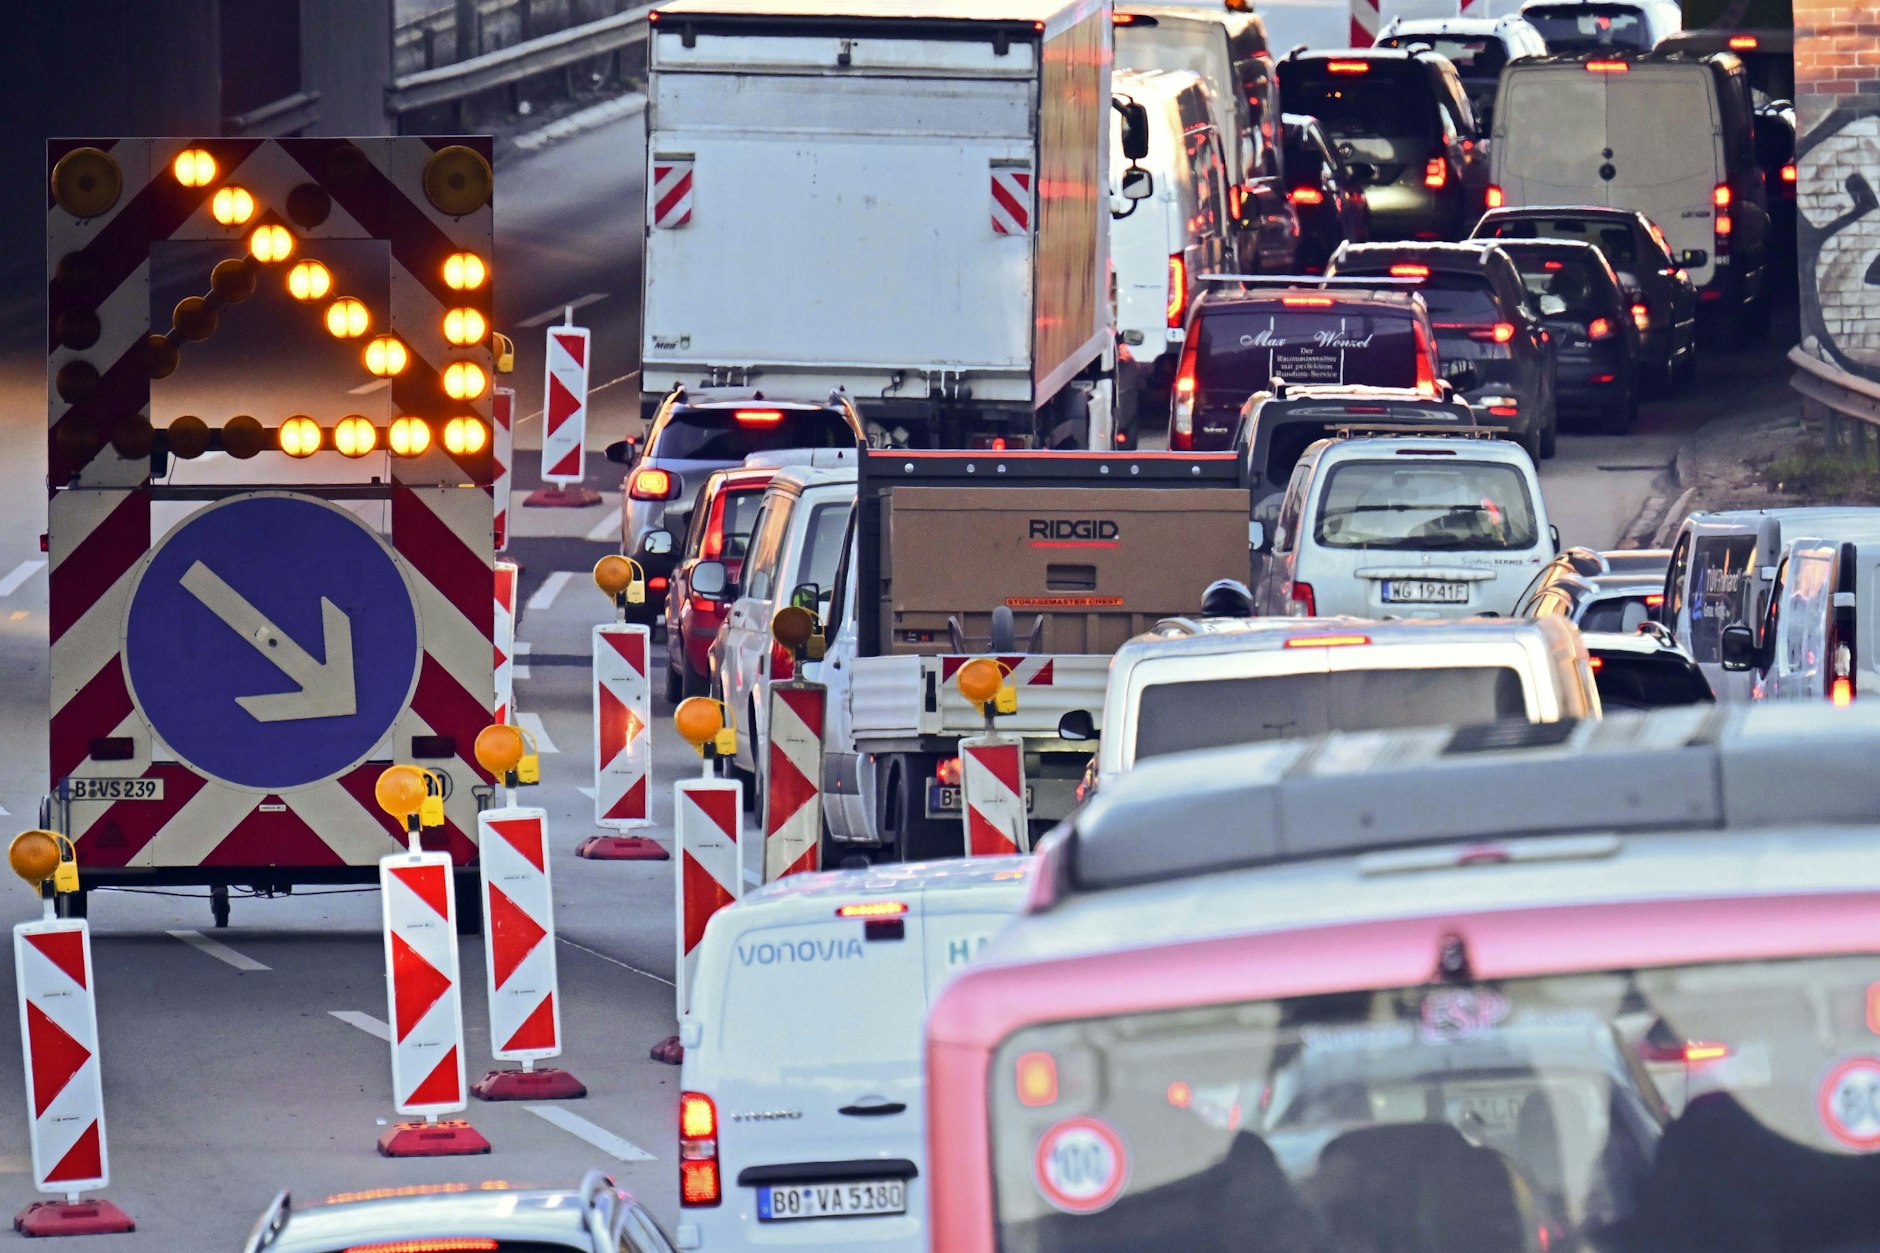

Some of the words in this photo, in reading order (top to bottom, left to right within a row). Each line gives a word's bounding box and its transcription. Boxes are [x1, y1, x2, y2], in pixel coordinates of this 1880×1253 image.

[1240, 330, 1286, 347] Max
[1300, 347, 1314, 355] Der
[1029, 519, 1119, 539] RIDGID
[1391, 583, 1412, 599] WG
[1419, 584, 1465, 600] 1941F
[75, 781, 86, 797] B
[99, 780, 121, 797] VS
[124, 780, 156, 798] 239
[942, 789, 952, 806] B
[817, 1187, 843, 1211] VA
